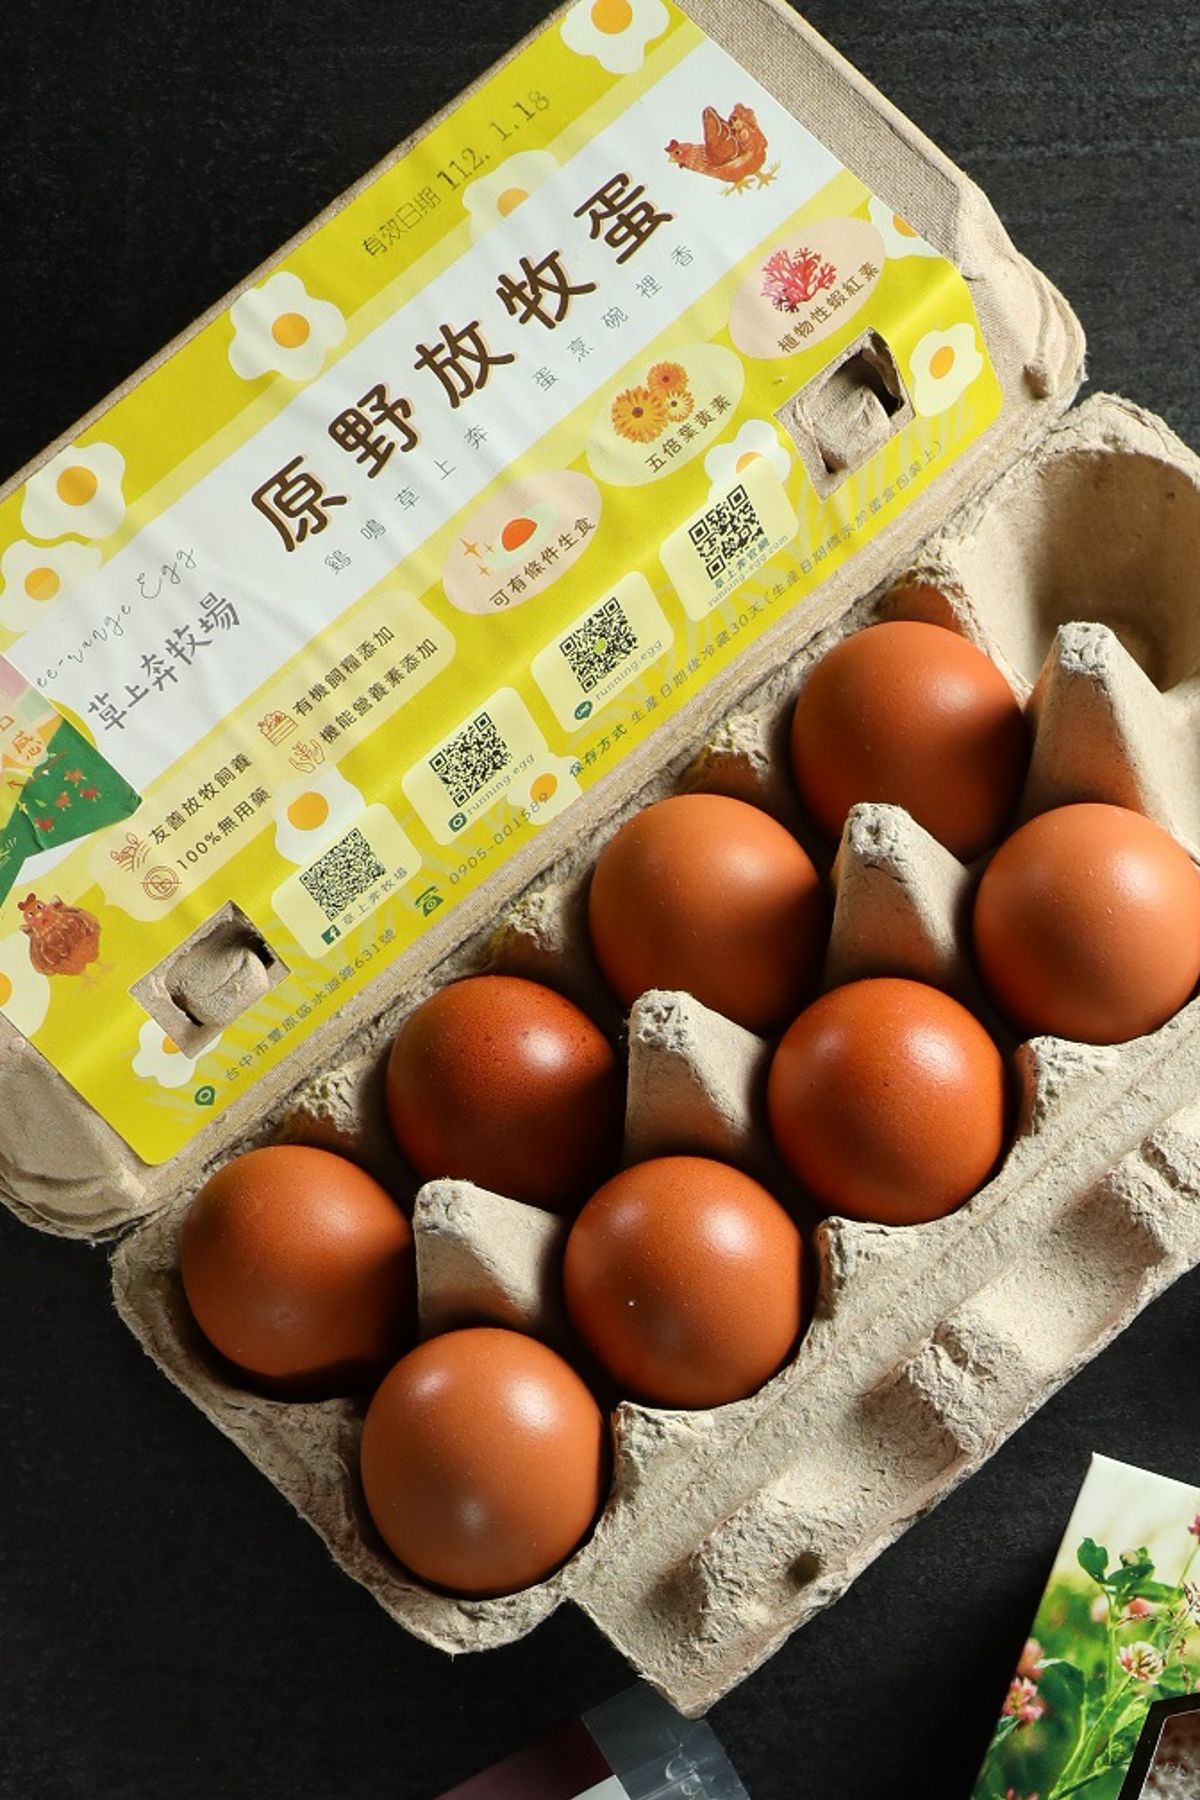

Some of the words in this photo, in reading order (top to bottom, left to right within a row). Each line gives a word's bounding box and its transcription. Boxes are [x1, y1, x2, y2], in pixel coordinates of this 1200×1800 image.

[359, 183, 443, 260] 有效日期
[776, 259, 881, 355] 植物性蝦紅素
[241, 163, 675, 557] 原野放牧蛋
[488, 512, 596, 611] 可有條件生食
[83, 585, 246, 739] 草上奔牧場
[317, 636, 439, 746] 機能營養素添加
[566, 722, 628, 778] 保存方式
[174, 782, 273, 873] 100%無用藥
[447, 790, 551, 885] 0905-001589
